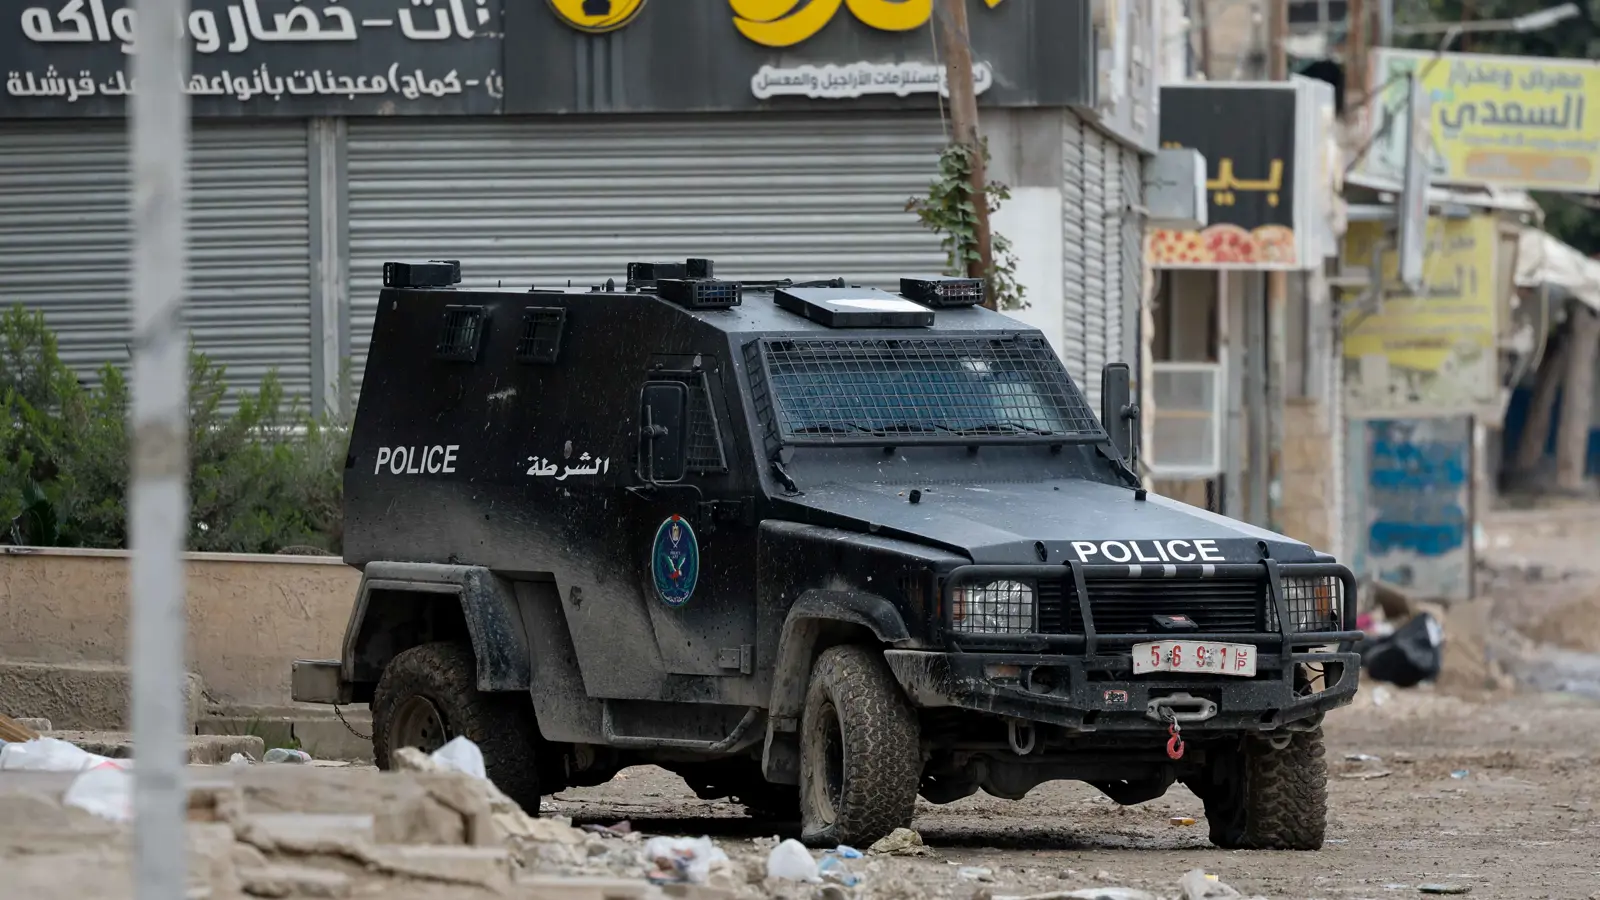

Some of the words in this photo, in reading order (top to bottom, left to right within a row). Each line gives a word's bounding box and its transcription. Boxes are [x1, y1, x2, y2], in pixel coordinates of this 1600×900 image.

[226, 0, 358, 52] خضار
[374, 444, 460, 475] POLICE
[526, 451, 610, 480] الشرطة
[1071, 539, 1226, 563] POLICE
